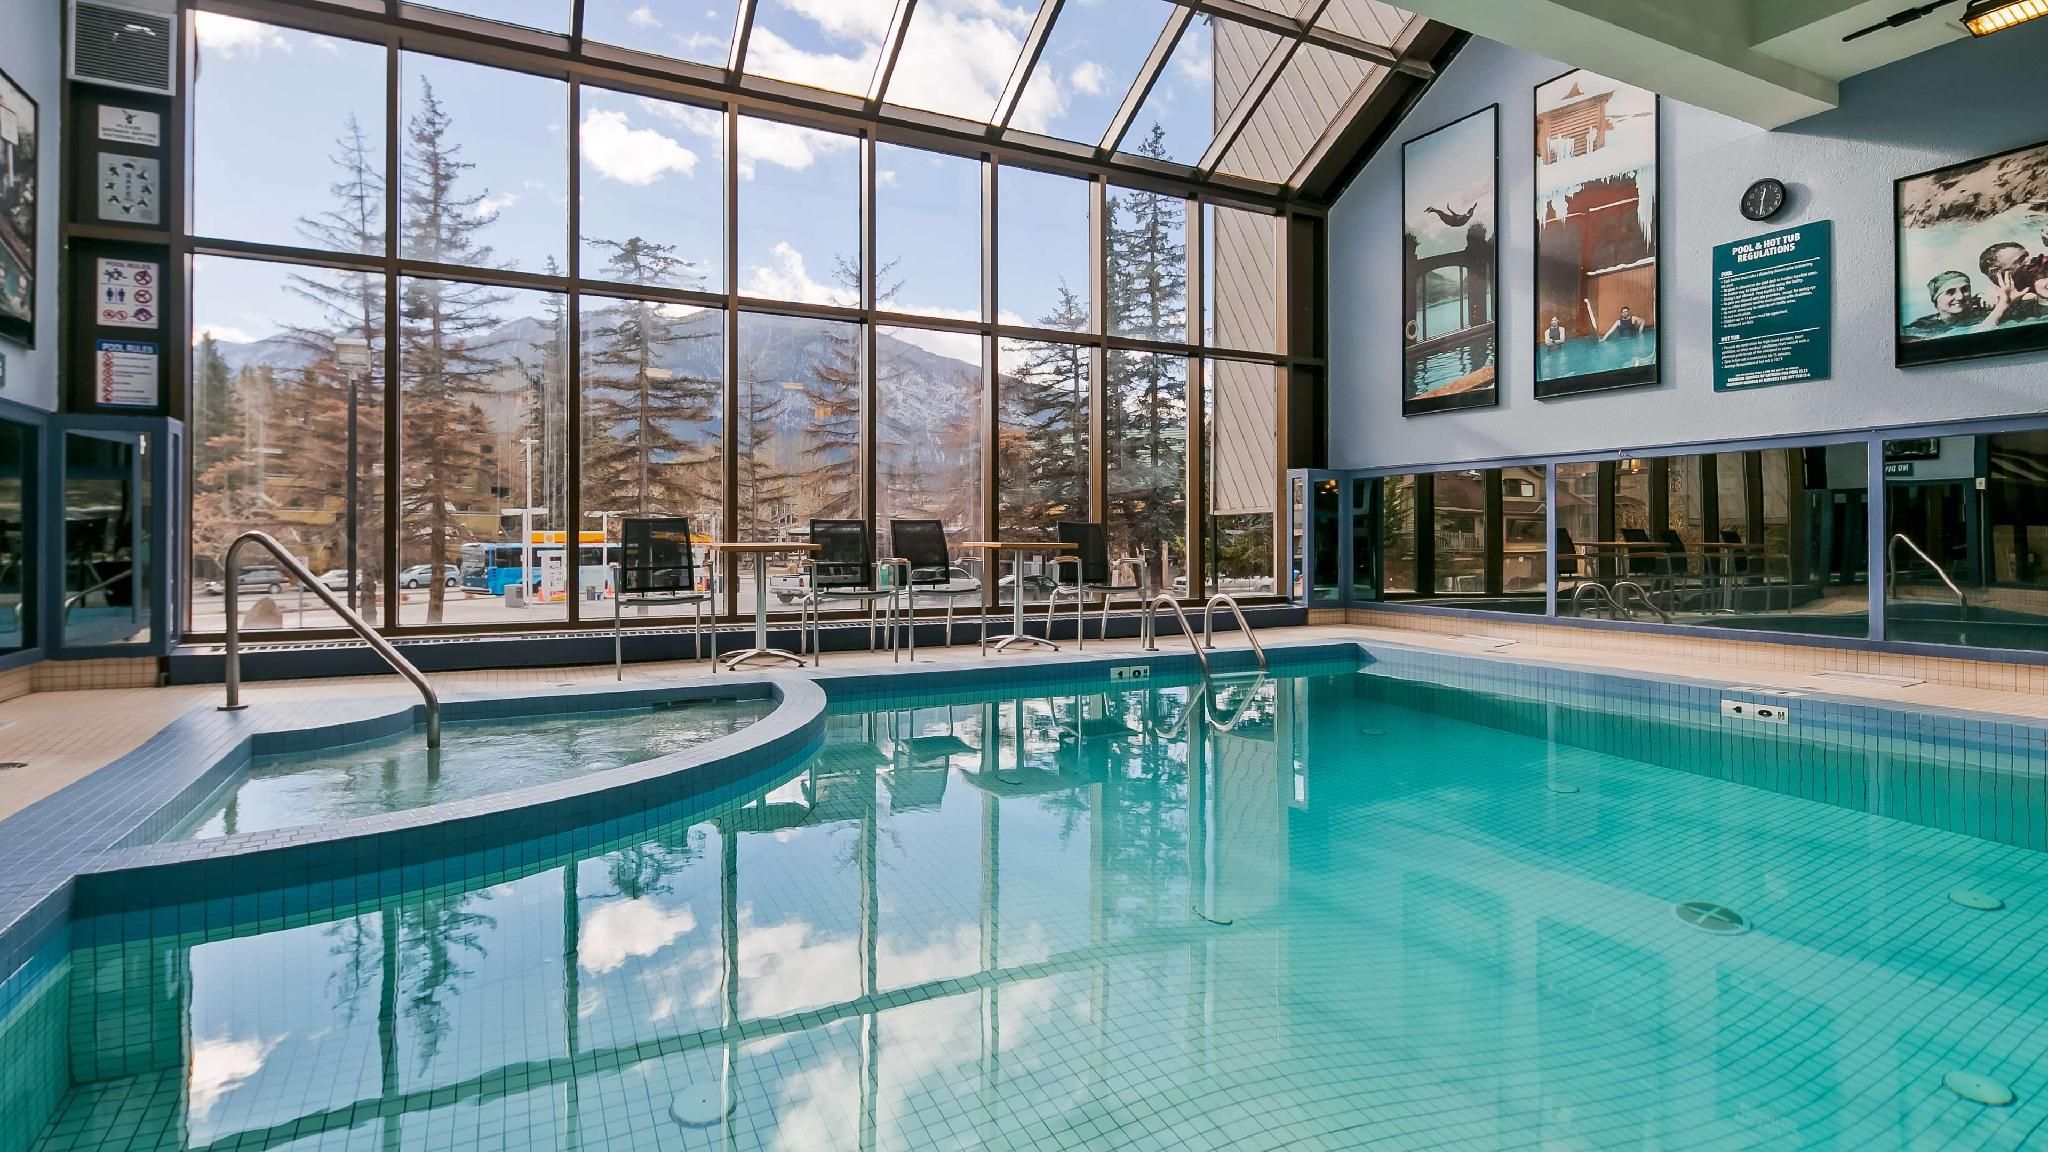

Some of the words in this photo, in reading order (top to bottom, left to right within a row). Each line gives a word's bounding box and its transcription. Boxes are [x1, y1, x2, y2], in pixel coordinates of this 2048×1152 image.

[1732, 243, 1754, 255] POOL
[1755, 242, 1762, 250] &
[1763, 237, 1782, 248] HOT
[1782, 232, 1801, 244] TUB
[1737, 243, 1796, 263] REGULATIONS
[101, 343, 124, 352] POOL
[126, 344, 153, 354] RULES
